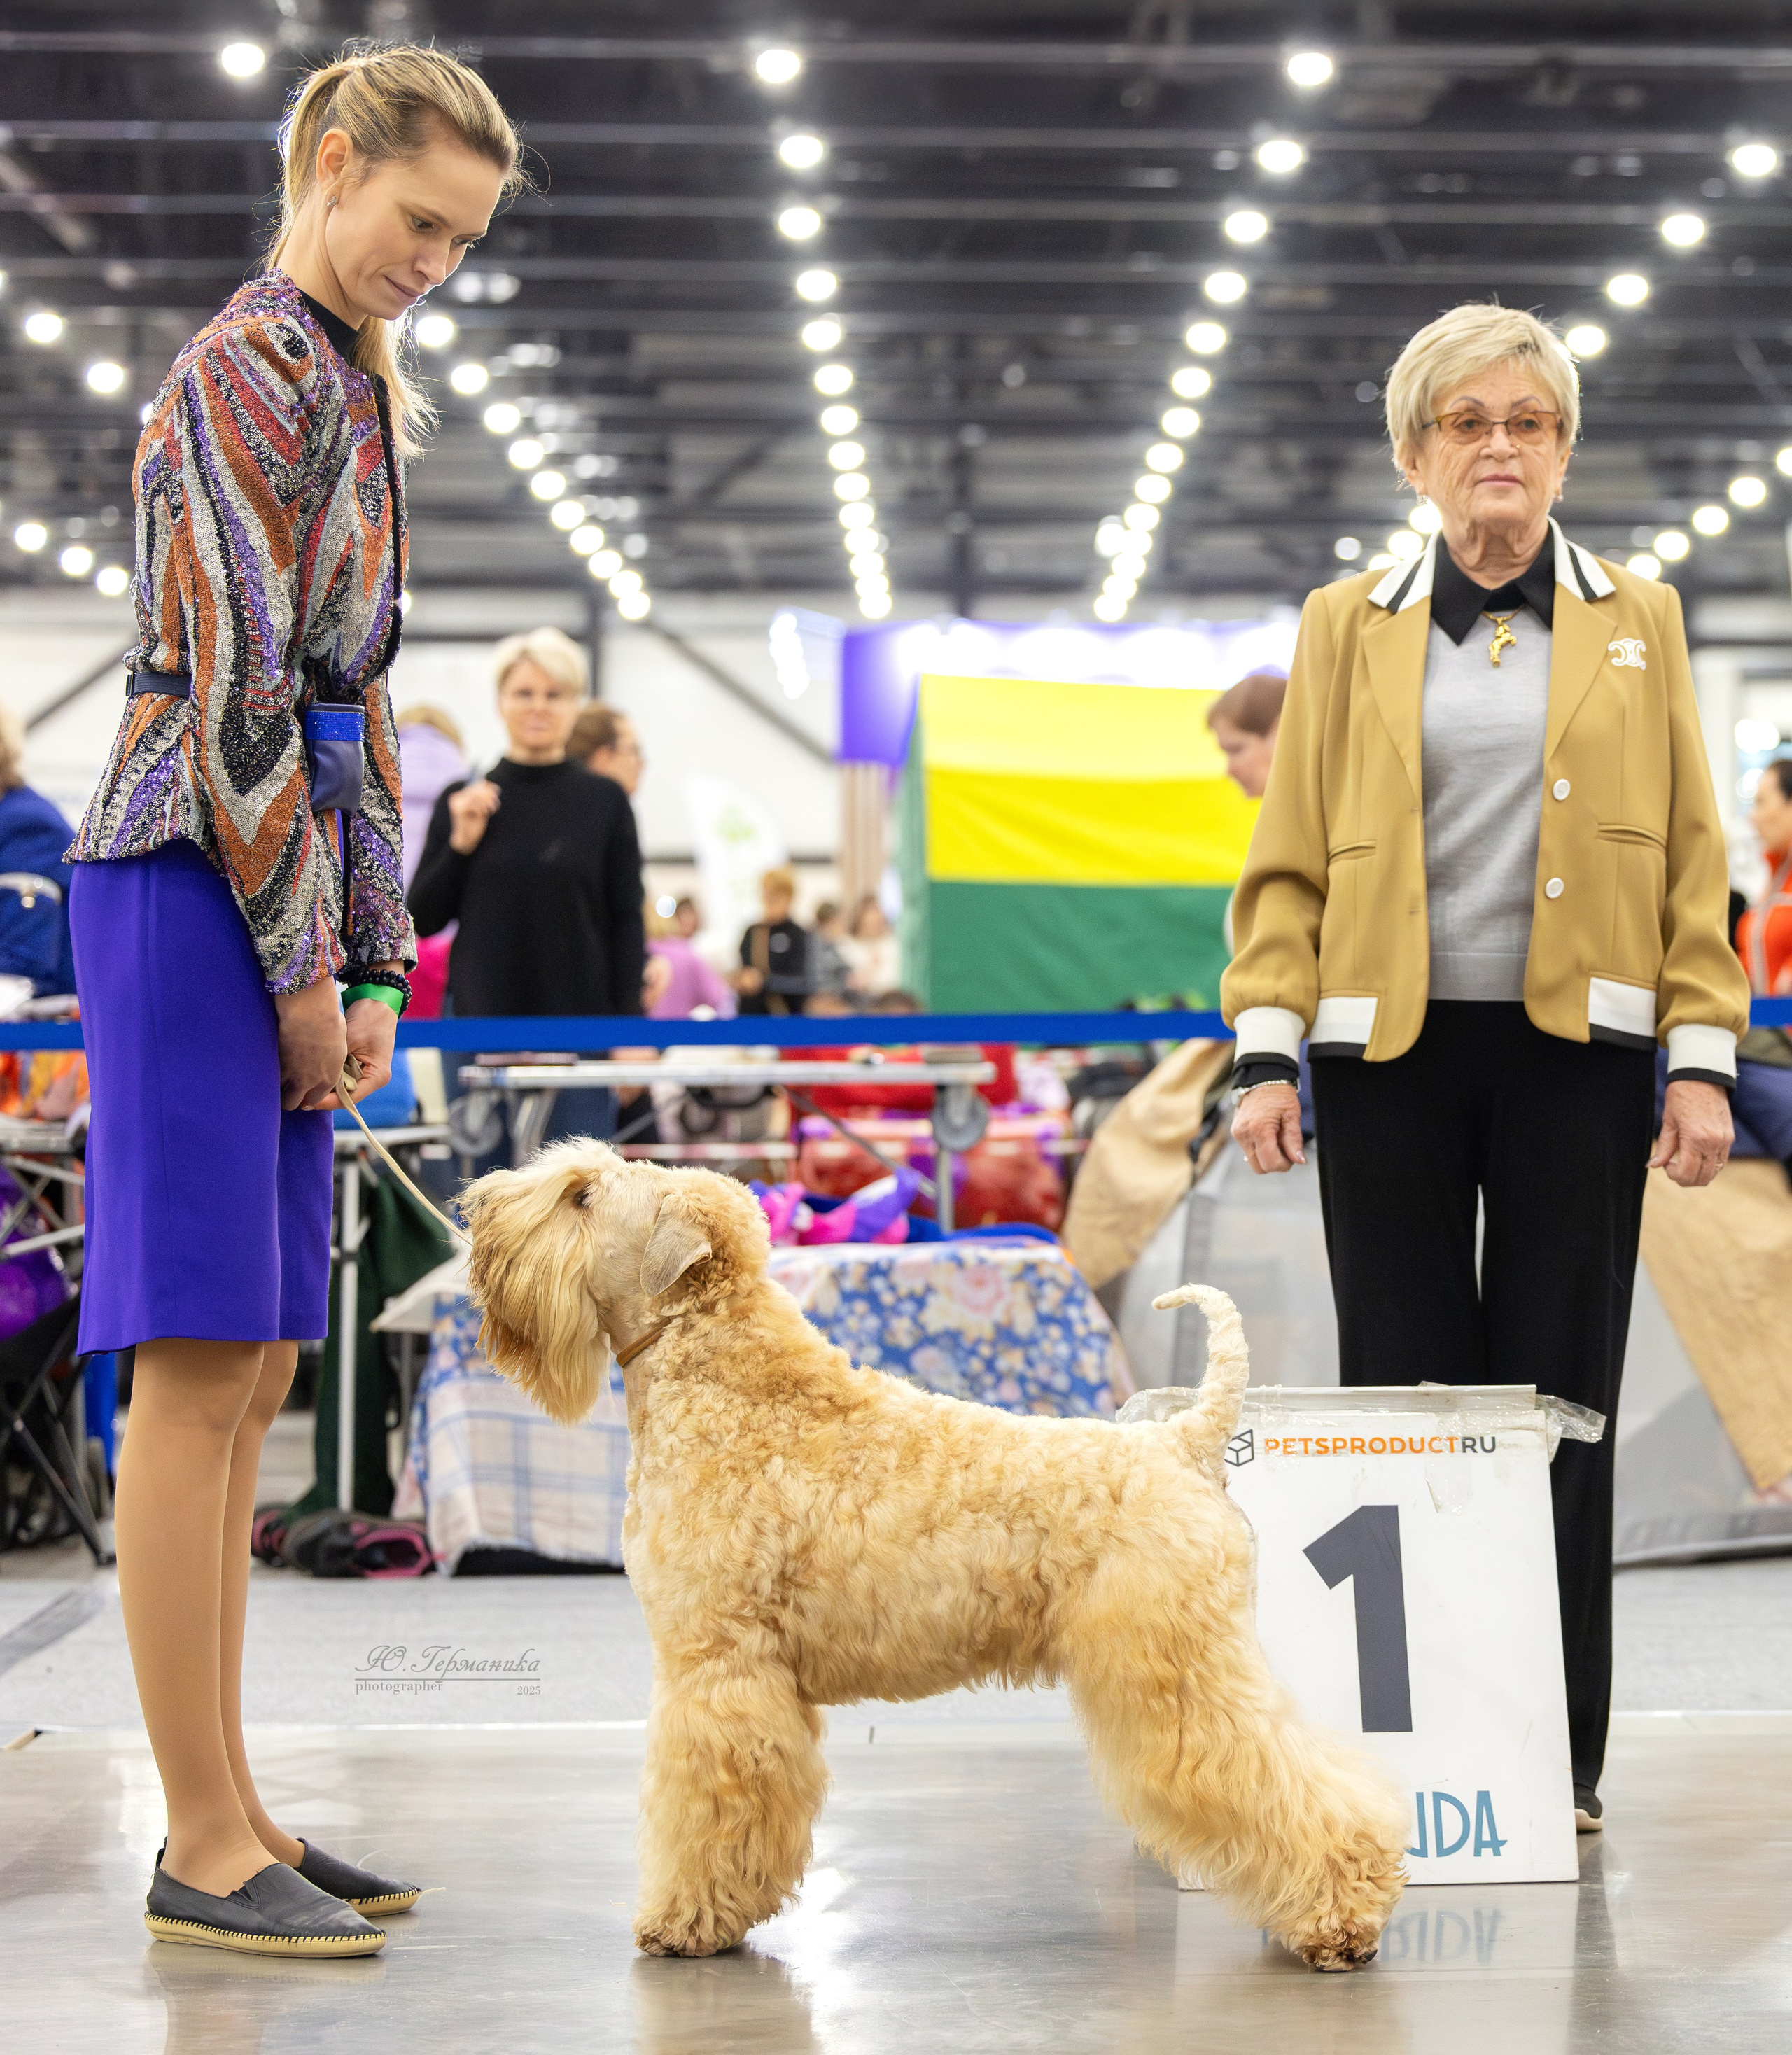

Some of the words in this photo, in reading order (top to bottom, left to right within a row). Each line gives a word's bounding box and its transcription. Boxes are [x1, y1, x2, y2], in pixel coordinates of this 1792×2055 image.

[1264, 1436, 1497, 1455] PETSPRODUCTRU
[1302, 1504, 1413, 1733] 1
[1406, 1790, 1508, 1858] IDA
